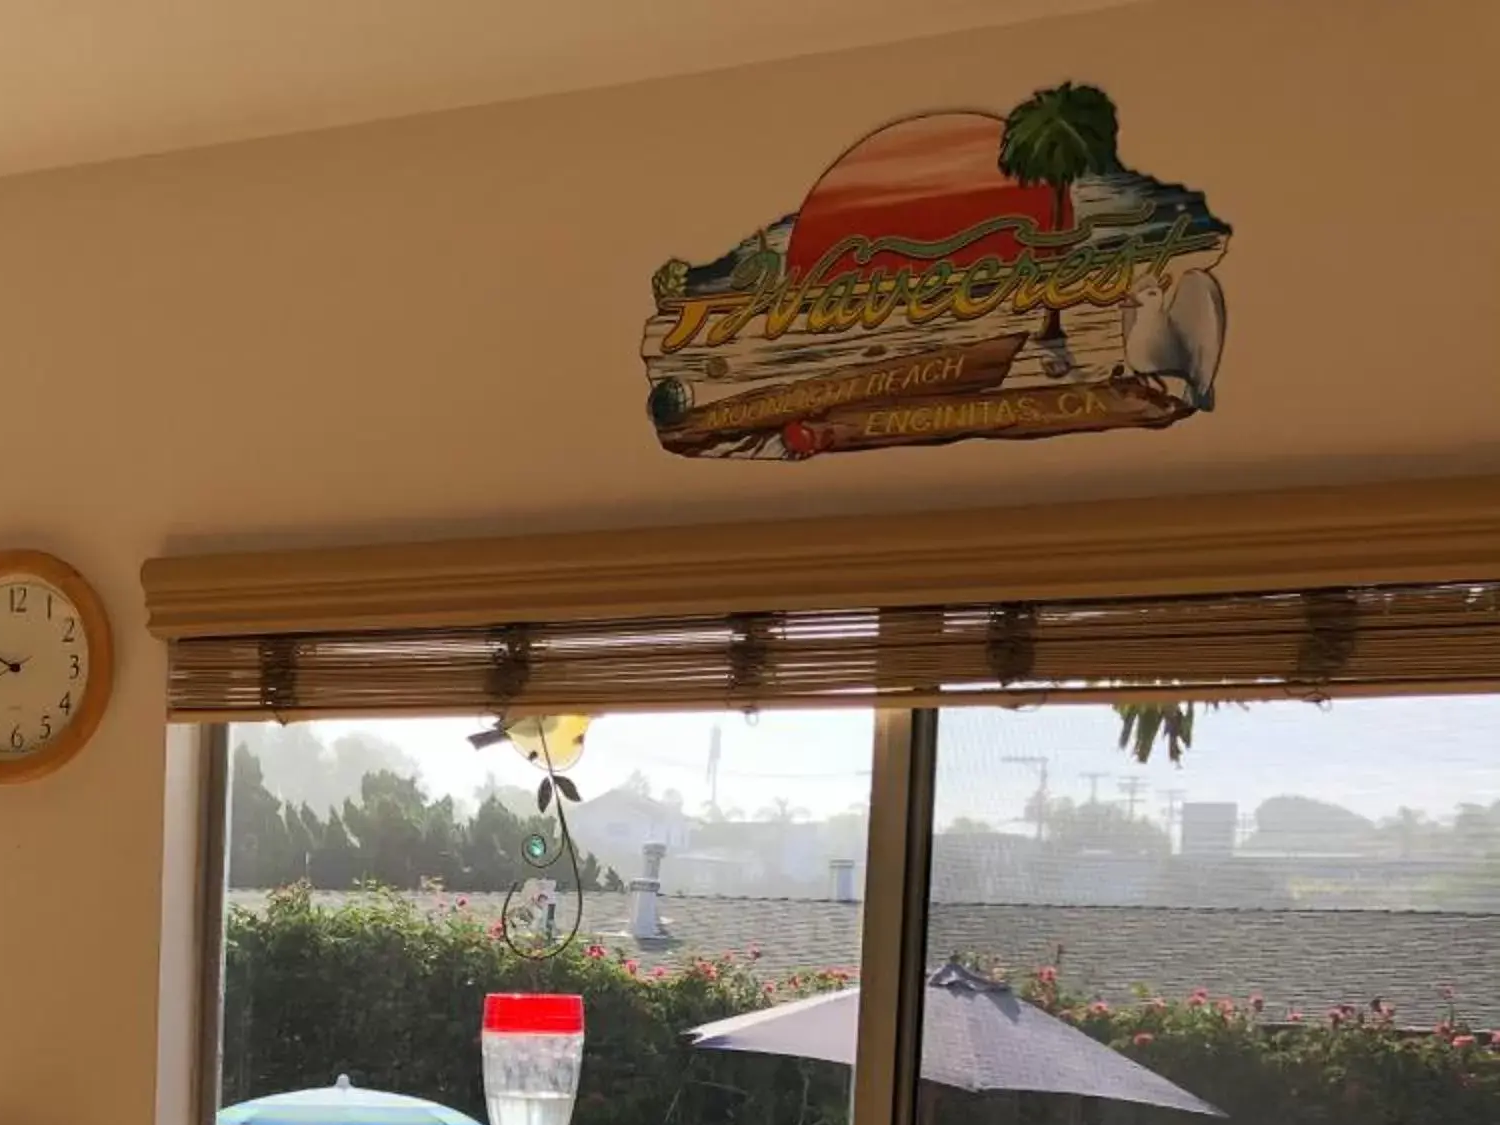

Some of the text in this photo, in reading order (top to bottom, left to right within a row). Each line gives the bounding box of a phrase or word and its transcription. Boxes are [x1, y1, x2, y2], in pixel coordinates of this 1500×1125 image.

[660, 205, 1222, 353] Wavecrest
[867, 354, 965, 396] BEACH
[10, 587, 27, 613] 12
[46, 593, 53, 621] 1
[62, 617, 76, 643] 2
[69, 655, 80, 680] 3
[59, 690, 71, 716] 4
[11, 724, 24, 749] 6
[40, 715, 52, 740] 5
